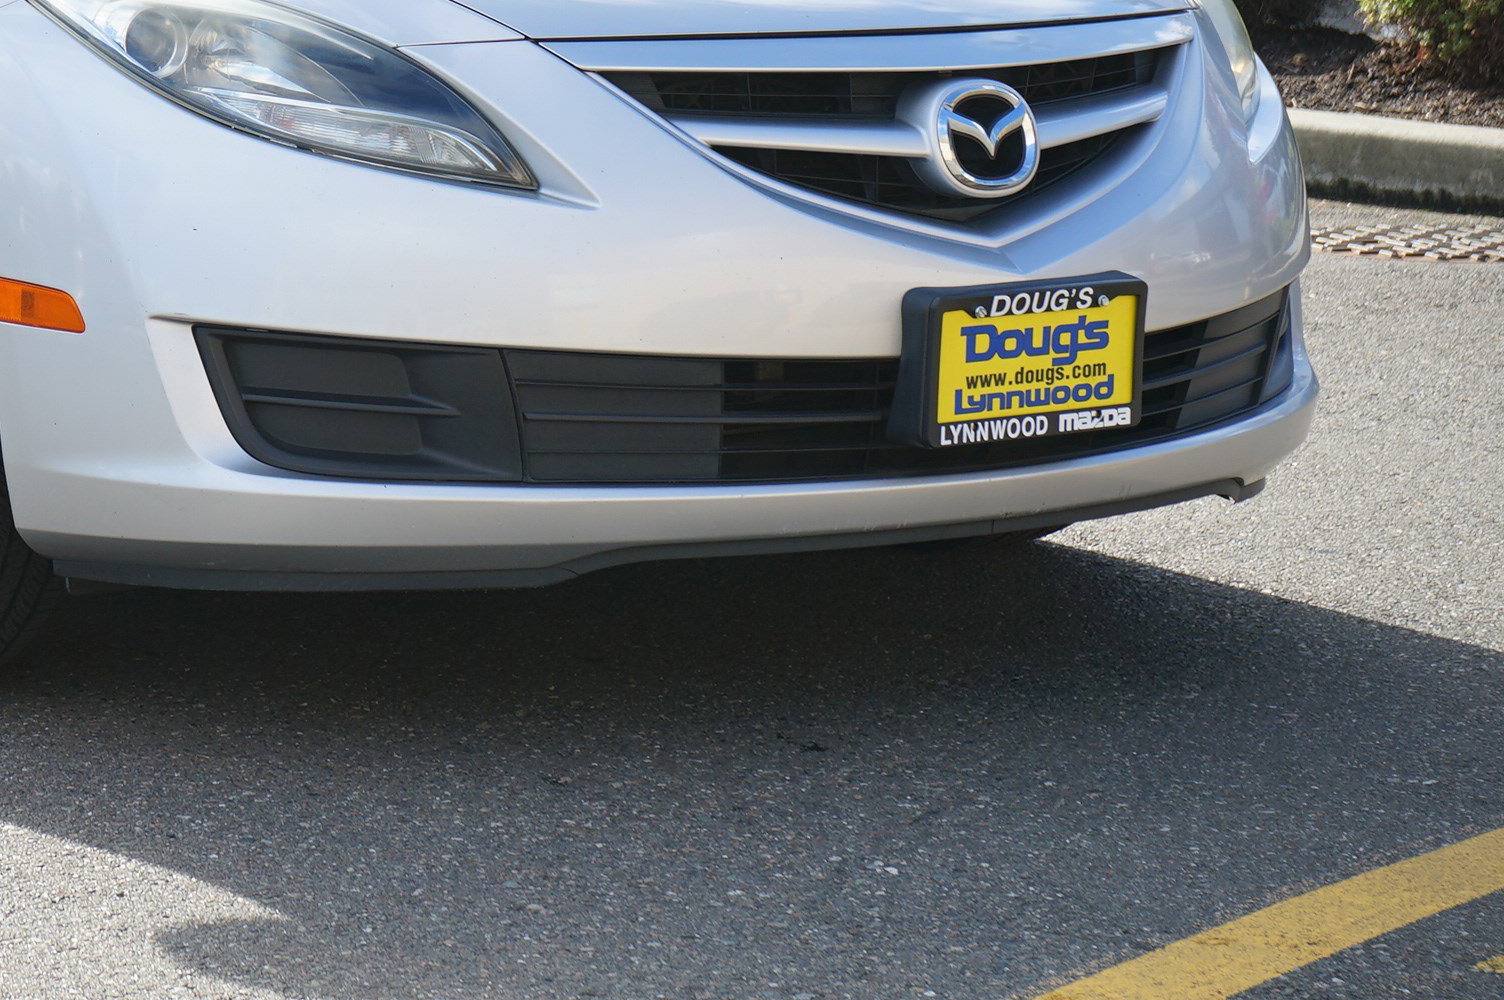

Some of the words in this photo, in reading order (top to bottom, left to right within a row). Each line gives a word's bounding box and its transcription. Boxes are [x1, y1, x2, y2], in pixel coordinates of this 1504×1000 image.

[990, 287, 1094, 317] DOUG'S
[966, 362, 1107, 390] www.dougs.com
[954, 374, 1115, 415] Lynnwood
[940, 415, 1049, 446] LYNNWOOD
